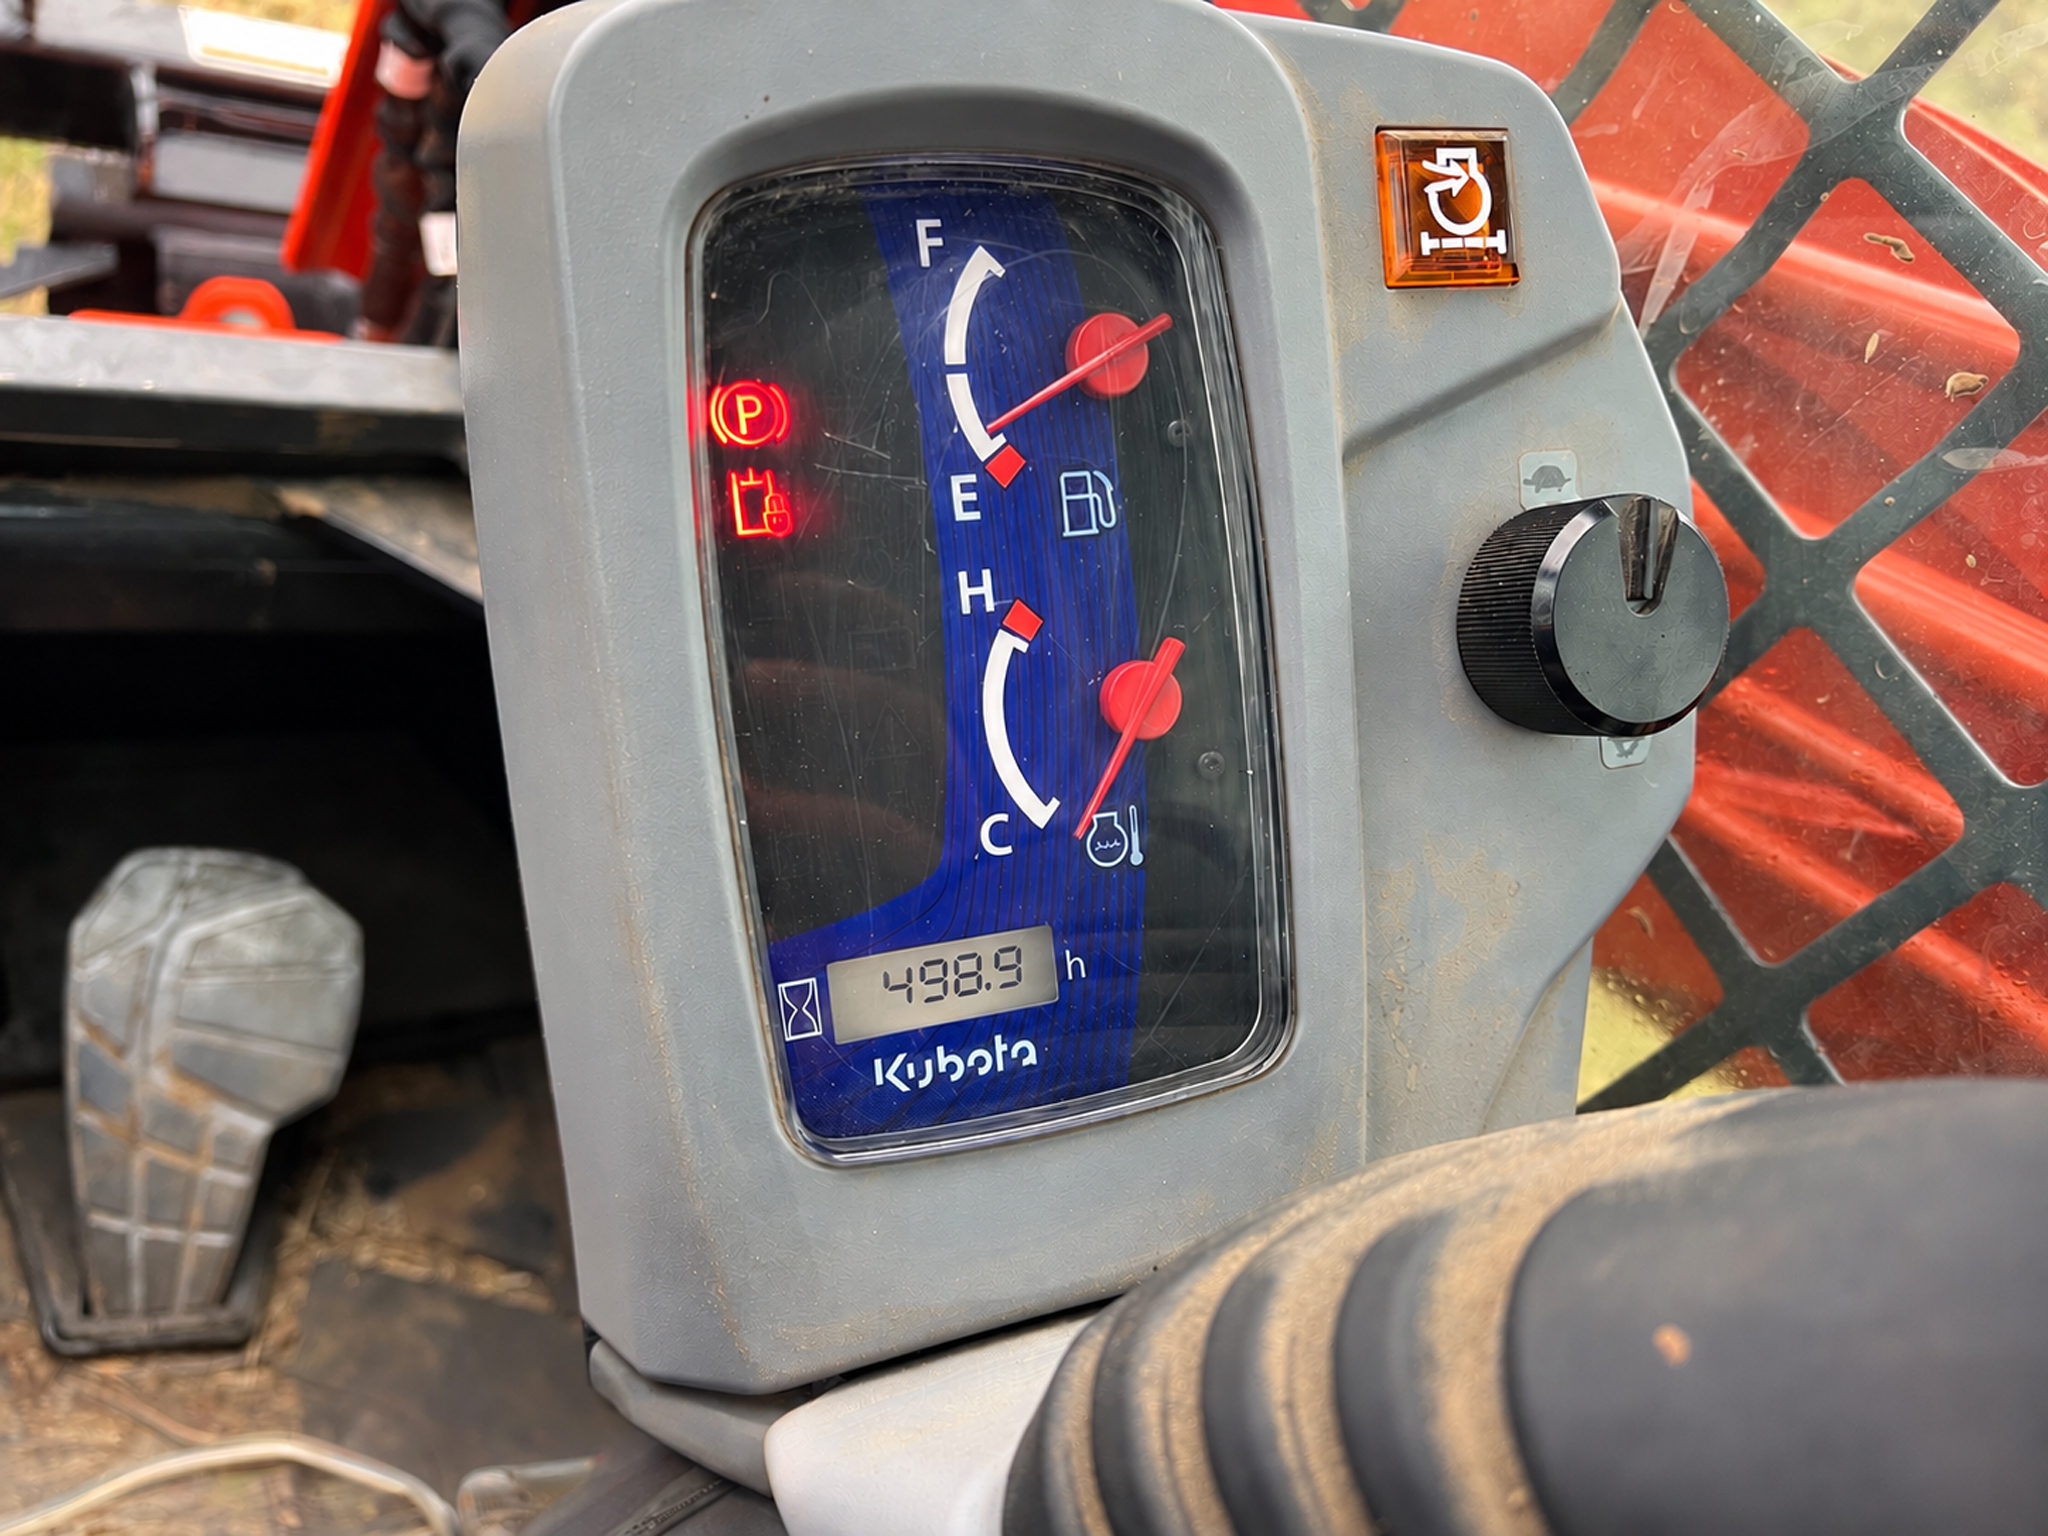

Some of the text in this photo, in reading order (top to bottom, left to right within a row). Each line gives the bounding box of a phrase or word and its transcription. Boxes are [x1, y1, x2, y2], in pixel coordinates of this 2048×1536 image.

[916, 219, 944, 267] F
[735, 393, 763, 436] P
[949, 473, 982, 522] E
[957, 567, 996, 615] H
[979, 812, 1014, 857] C
[882, 944, 1087, 1004] 498.9 h
[873, 1033, 1038, 1093] Kubota
